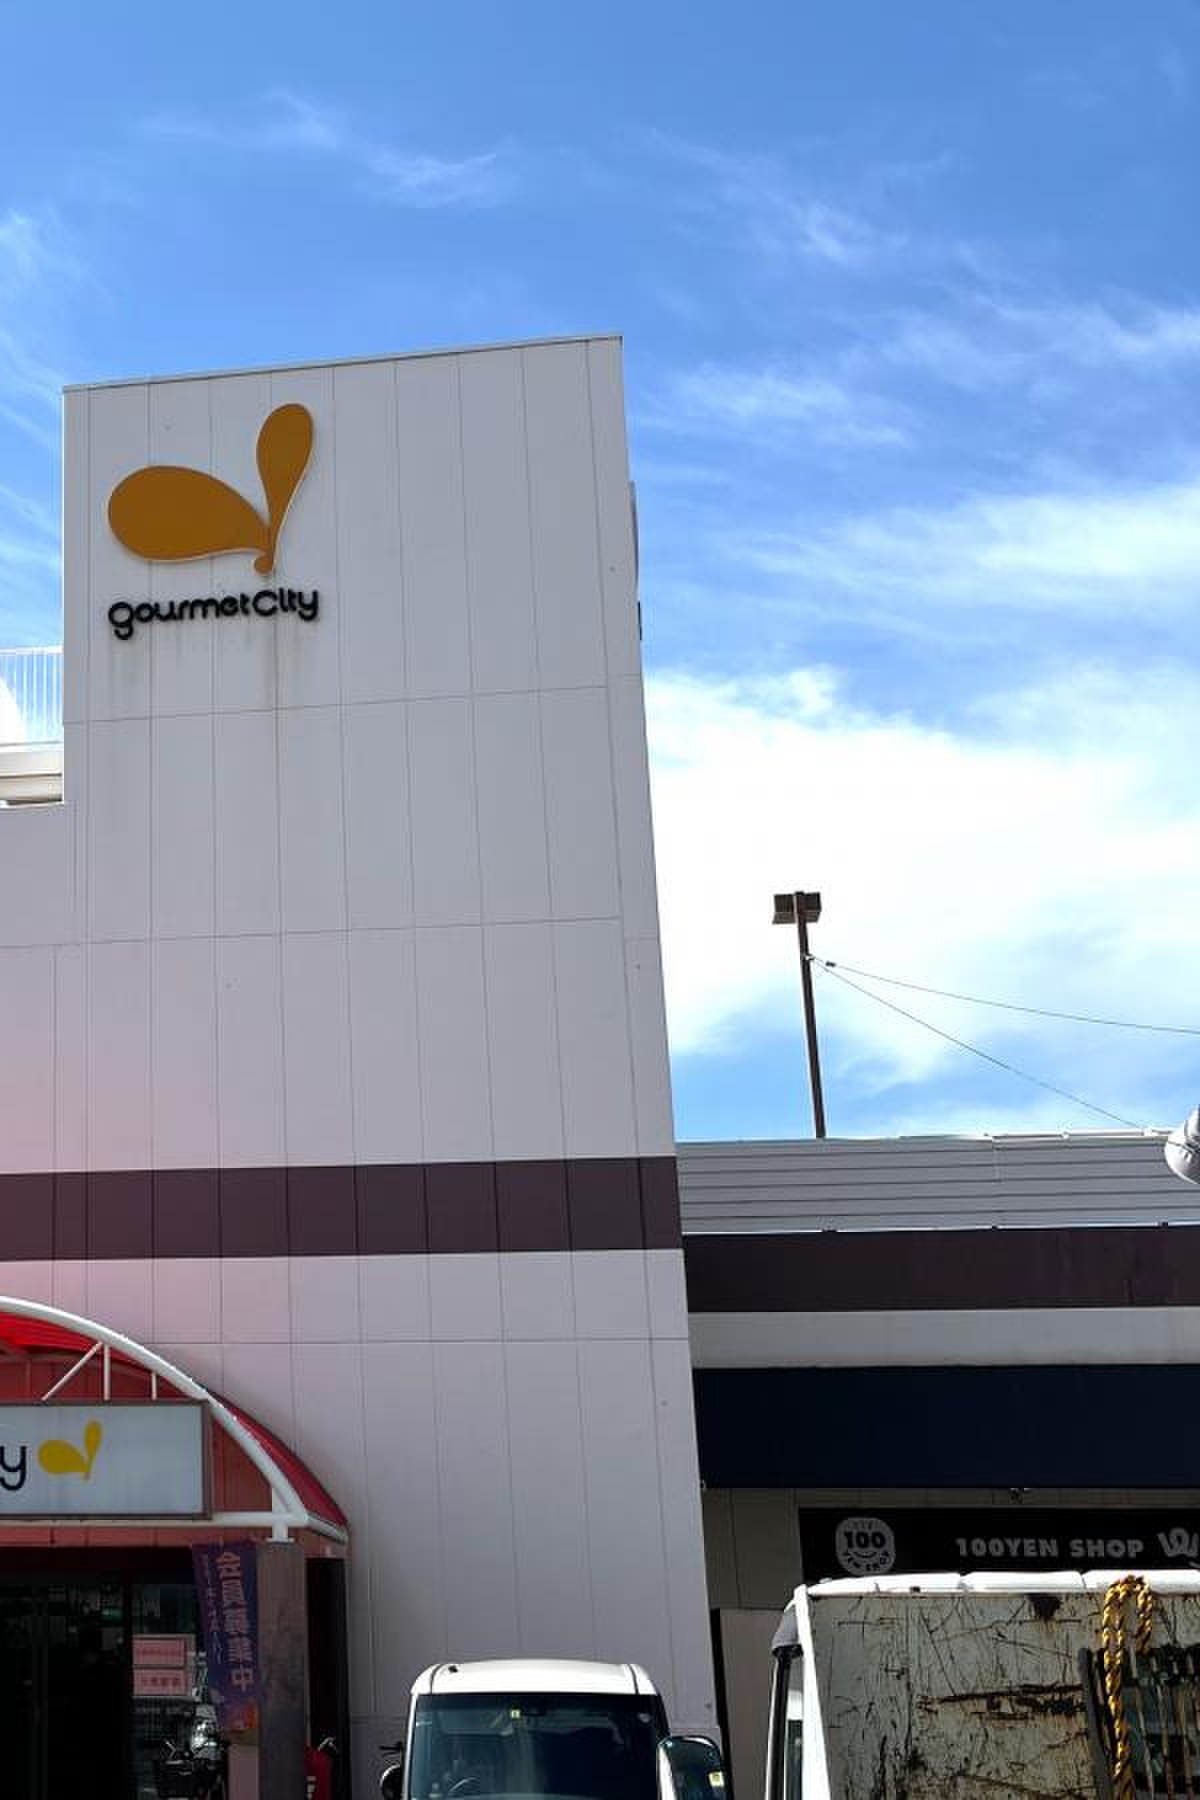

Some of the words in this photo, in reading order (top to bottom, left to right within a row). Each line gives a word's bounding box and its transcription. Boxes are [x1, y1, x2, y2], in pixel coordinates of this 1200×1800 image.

[108, 587, 319, 640] gourmetCity
[844, 1531, 885, 1548] 100
[955, 1537, 1059, 1557] 100YEN
[1069, 1538, 1144, 1558] SHOP
